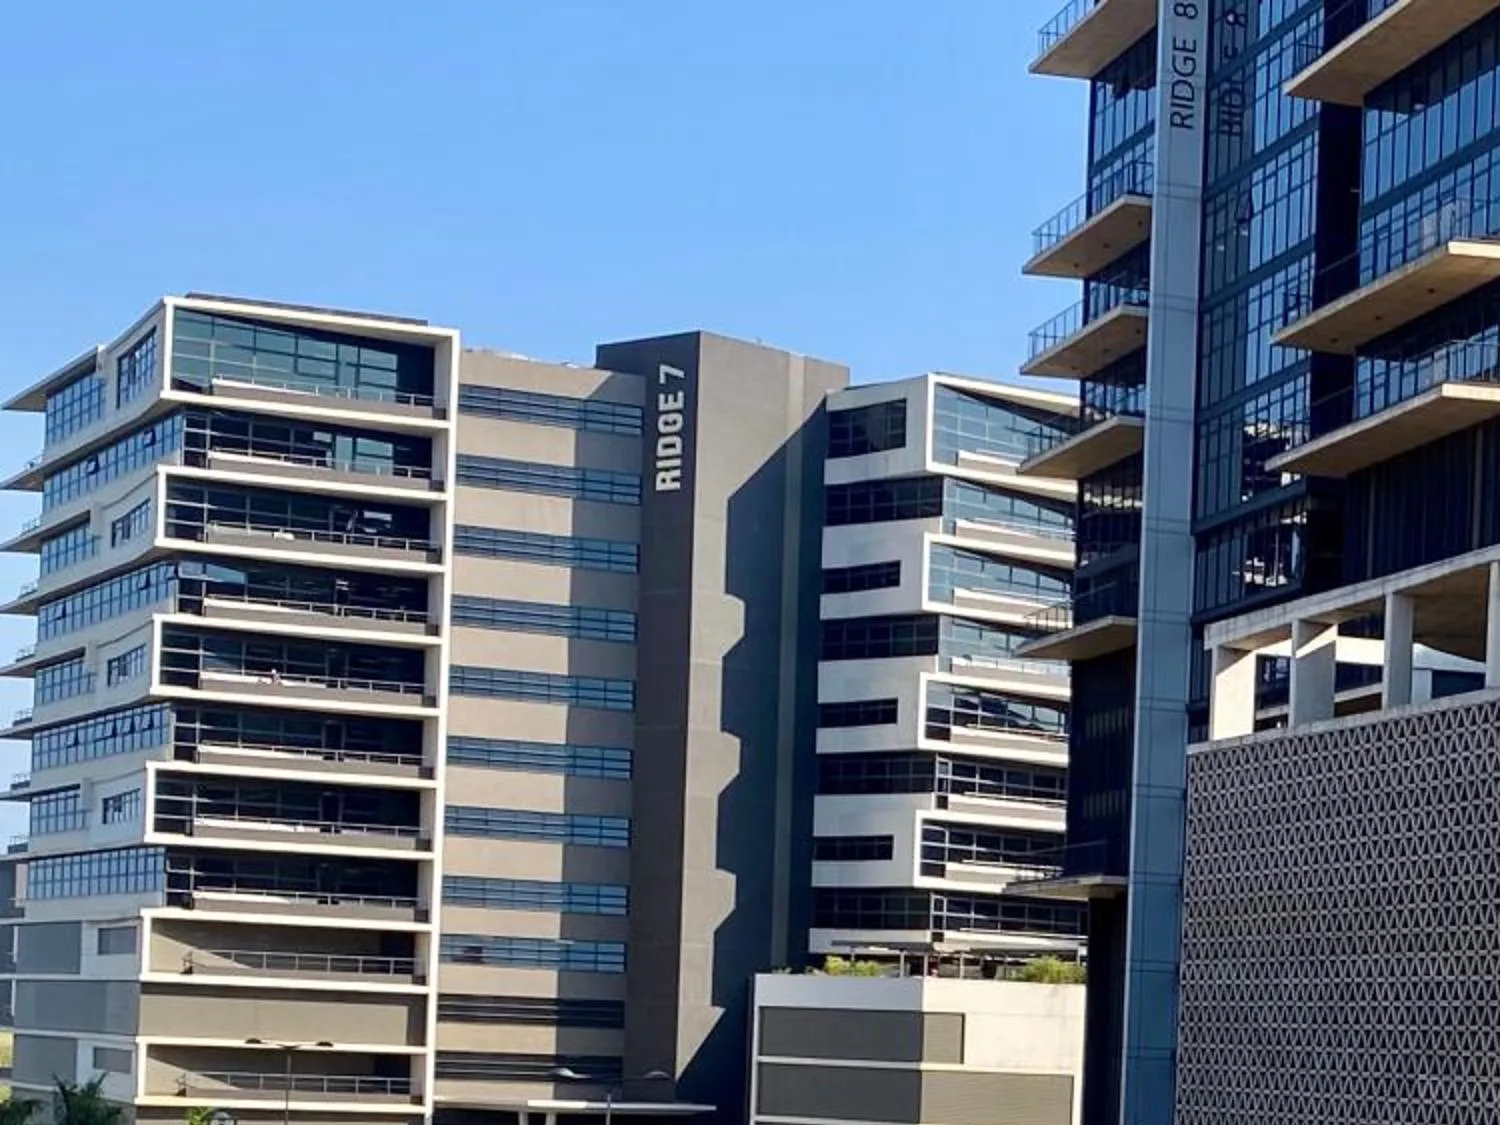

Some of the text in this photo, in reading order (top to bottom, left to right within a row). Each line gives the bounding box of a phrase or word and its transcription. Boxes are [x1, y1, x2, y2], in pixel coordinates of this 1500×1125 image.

[1170, 3, 1198, 130] RIDGE 8
[656, 363, 685, 491] RIDGE 7
